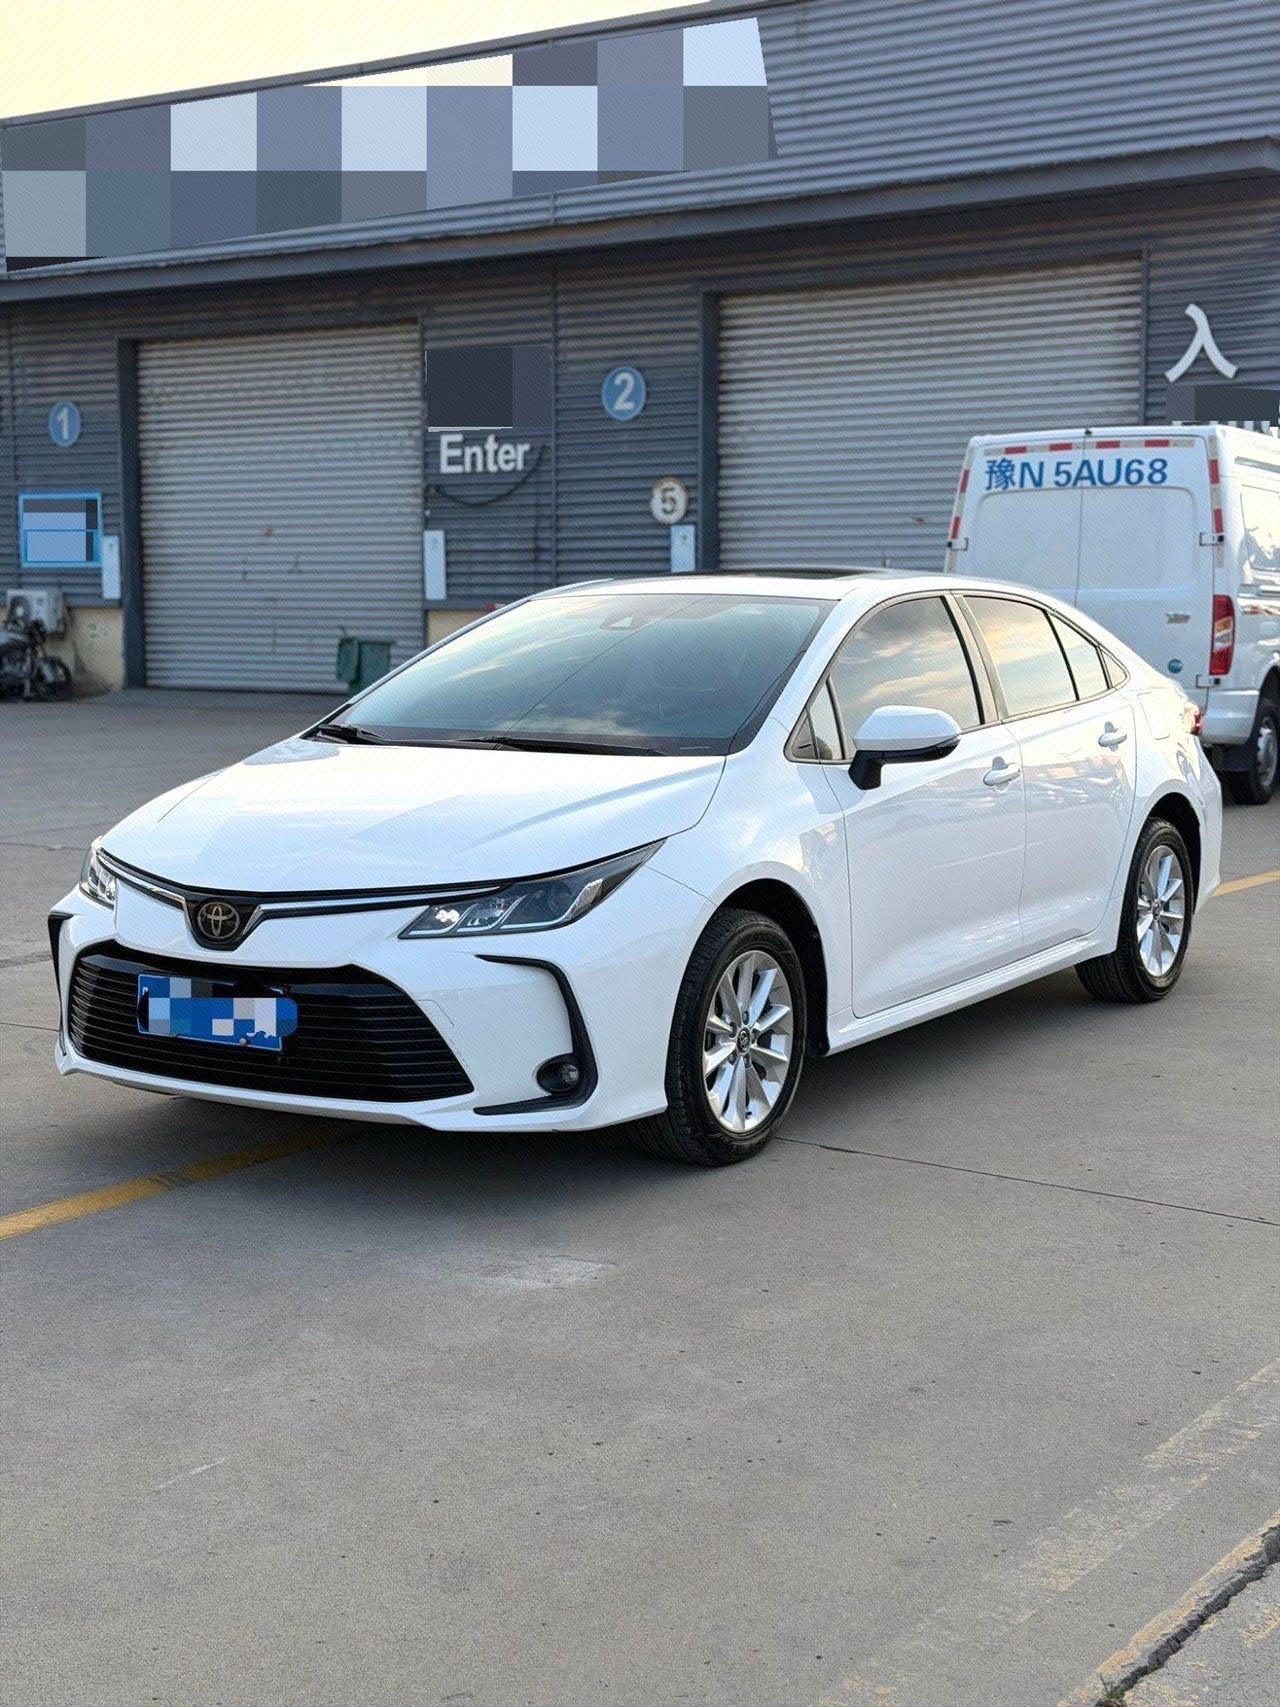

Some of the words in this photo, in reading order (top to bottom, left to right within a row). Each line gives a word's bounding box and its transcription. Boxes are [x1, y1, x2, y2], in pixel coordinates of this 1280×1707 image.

[1164, 303, 1238, 383] 入
[613, 372, 635, 411] 2
[56, 406, 70, 440] 1
[439, 433, 531, 474] Enter
[660, 487, 677, 514] 5
